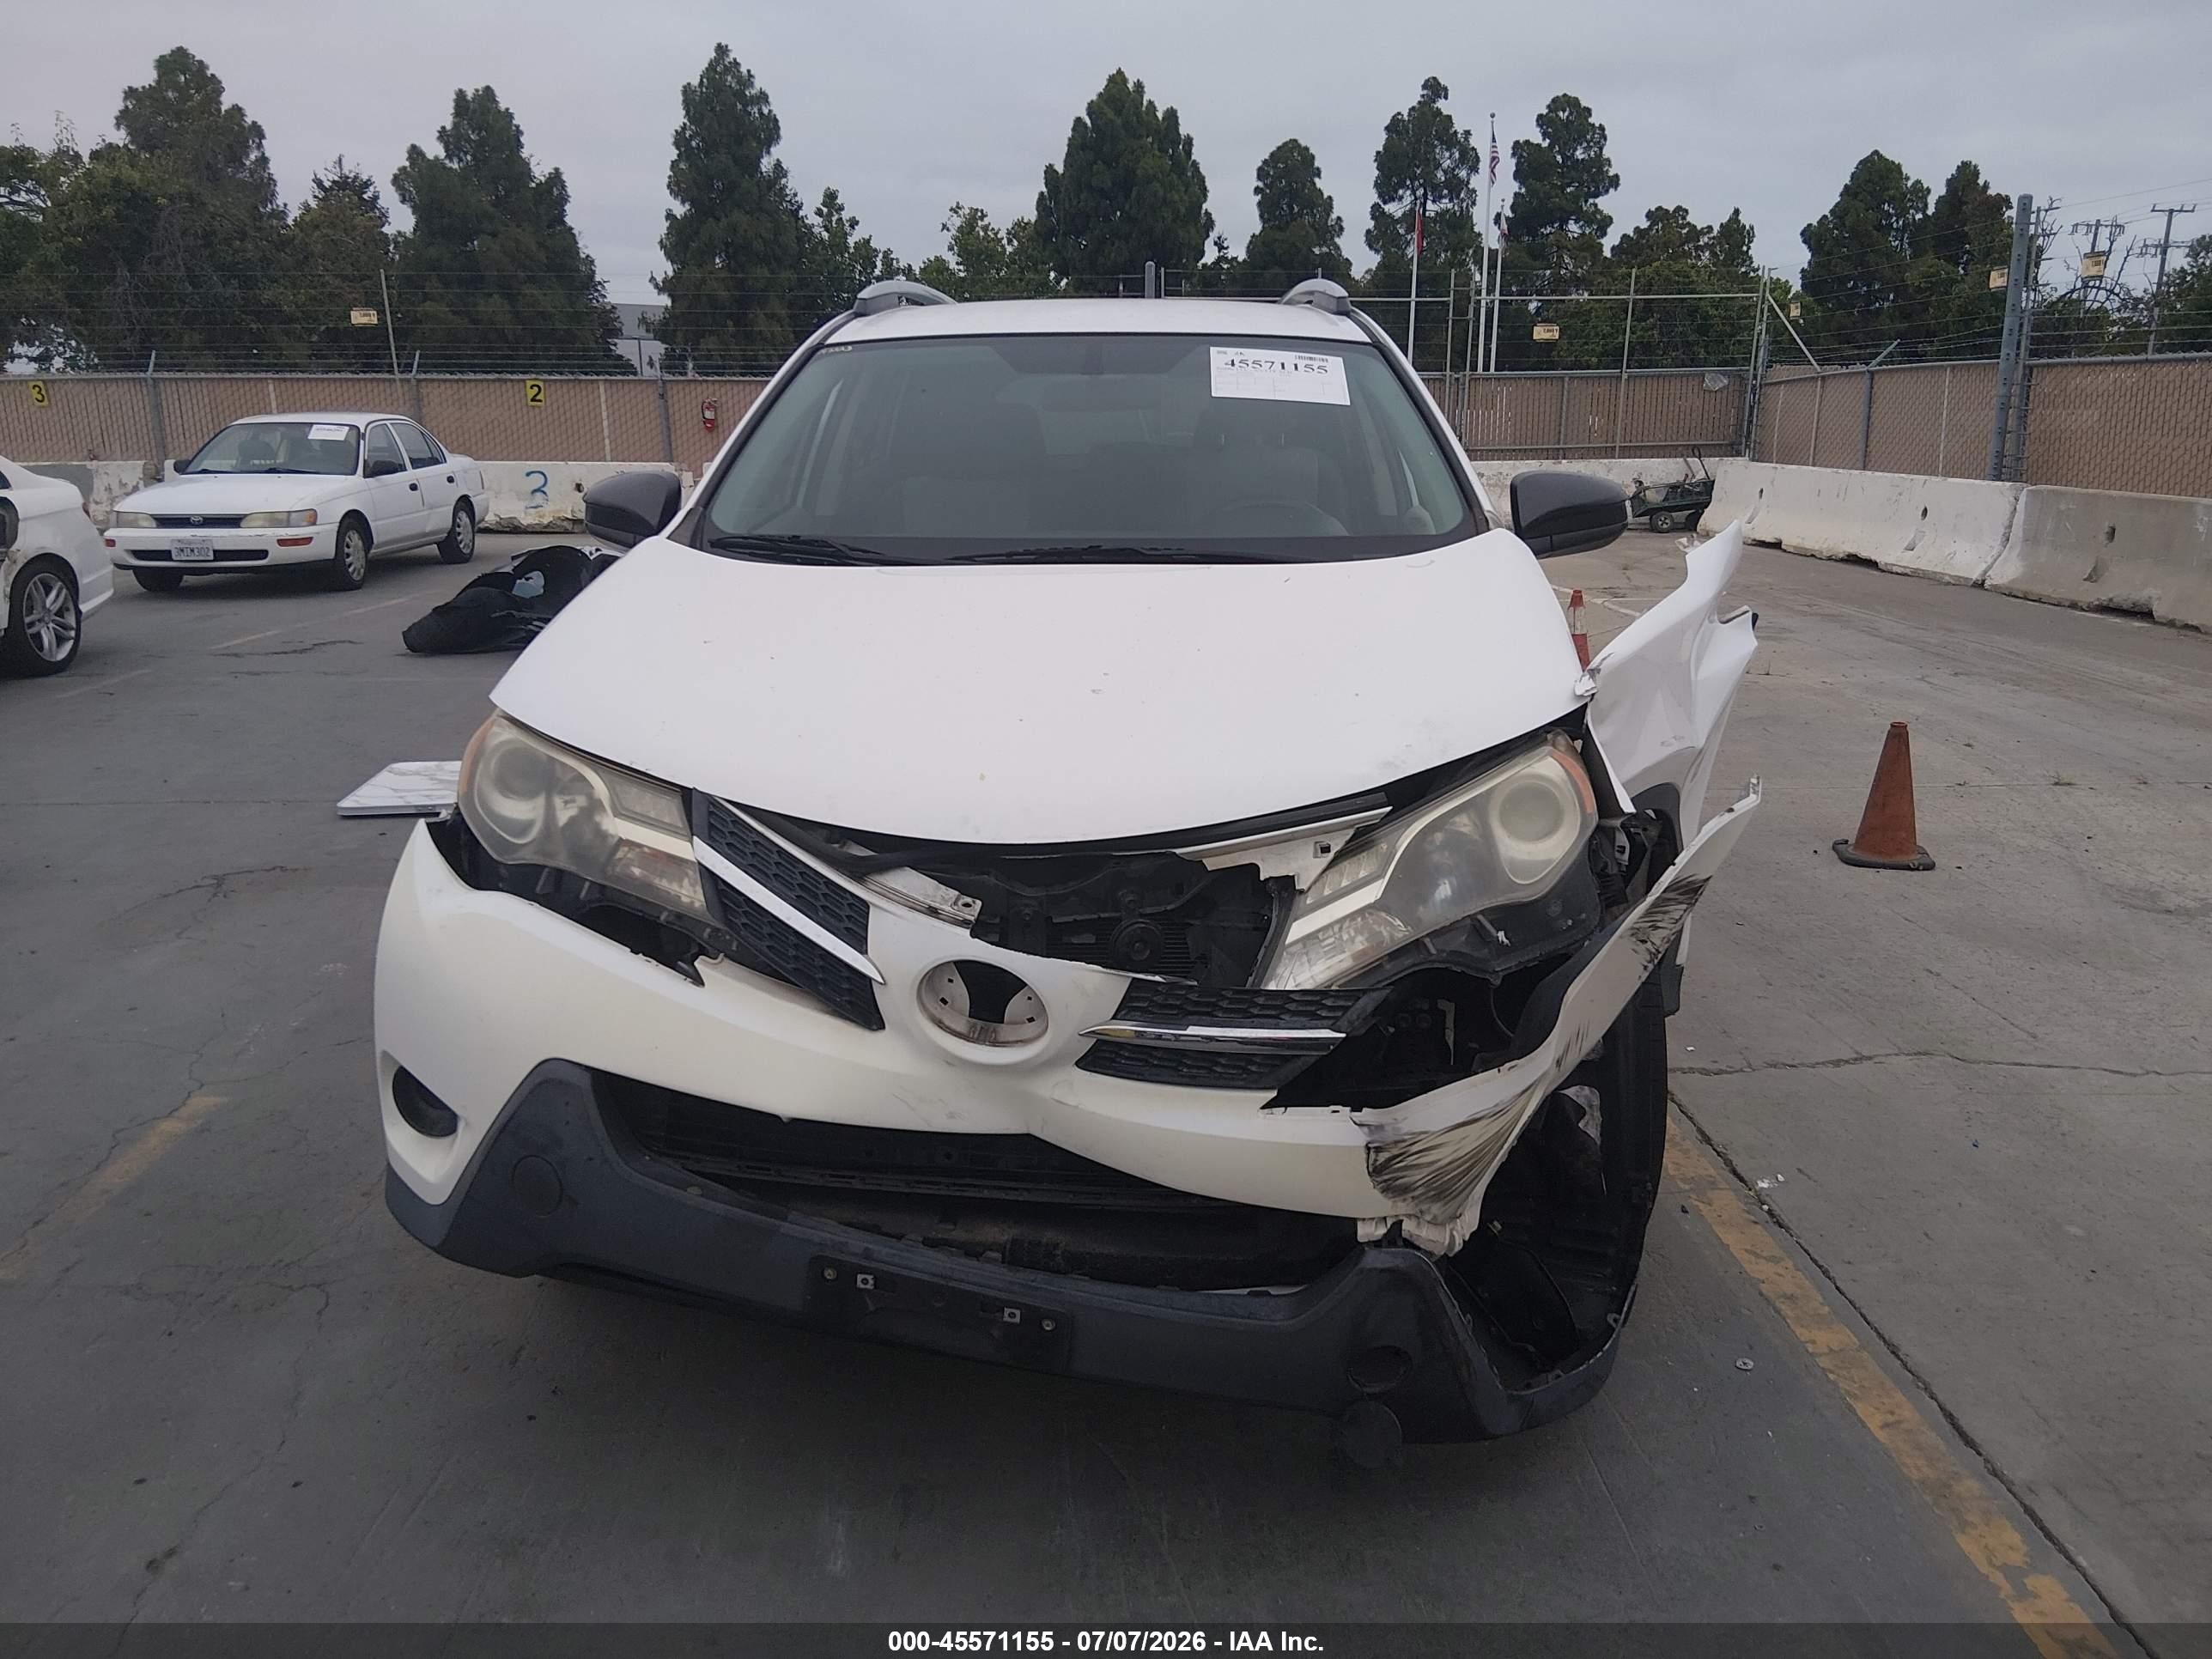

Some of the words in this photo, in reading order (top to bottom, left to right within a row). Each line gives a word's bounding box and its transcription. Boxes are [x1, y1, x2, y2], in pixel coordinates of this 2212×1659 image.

[1224, 358, 1328, 374] 45571155
[32, 384, 46, 404] 3
[529, 383, 544, 403] 2
